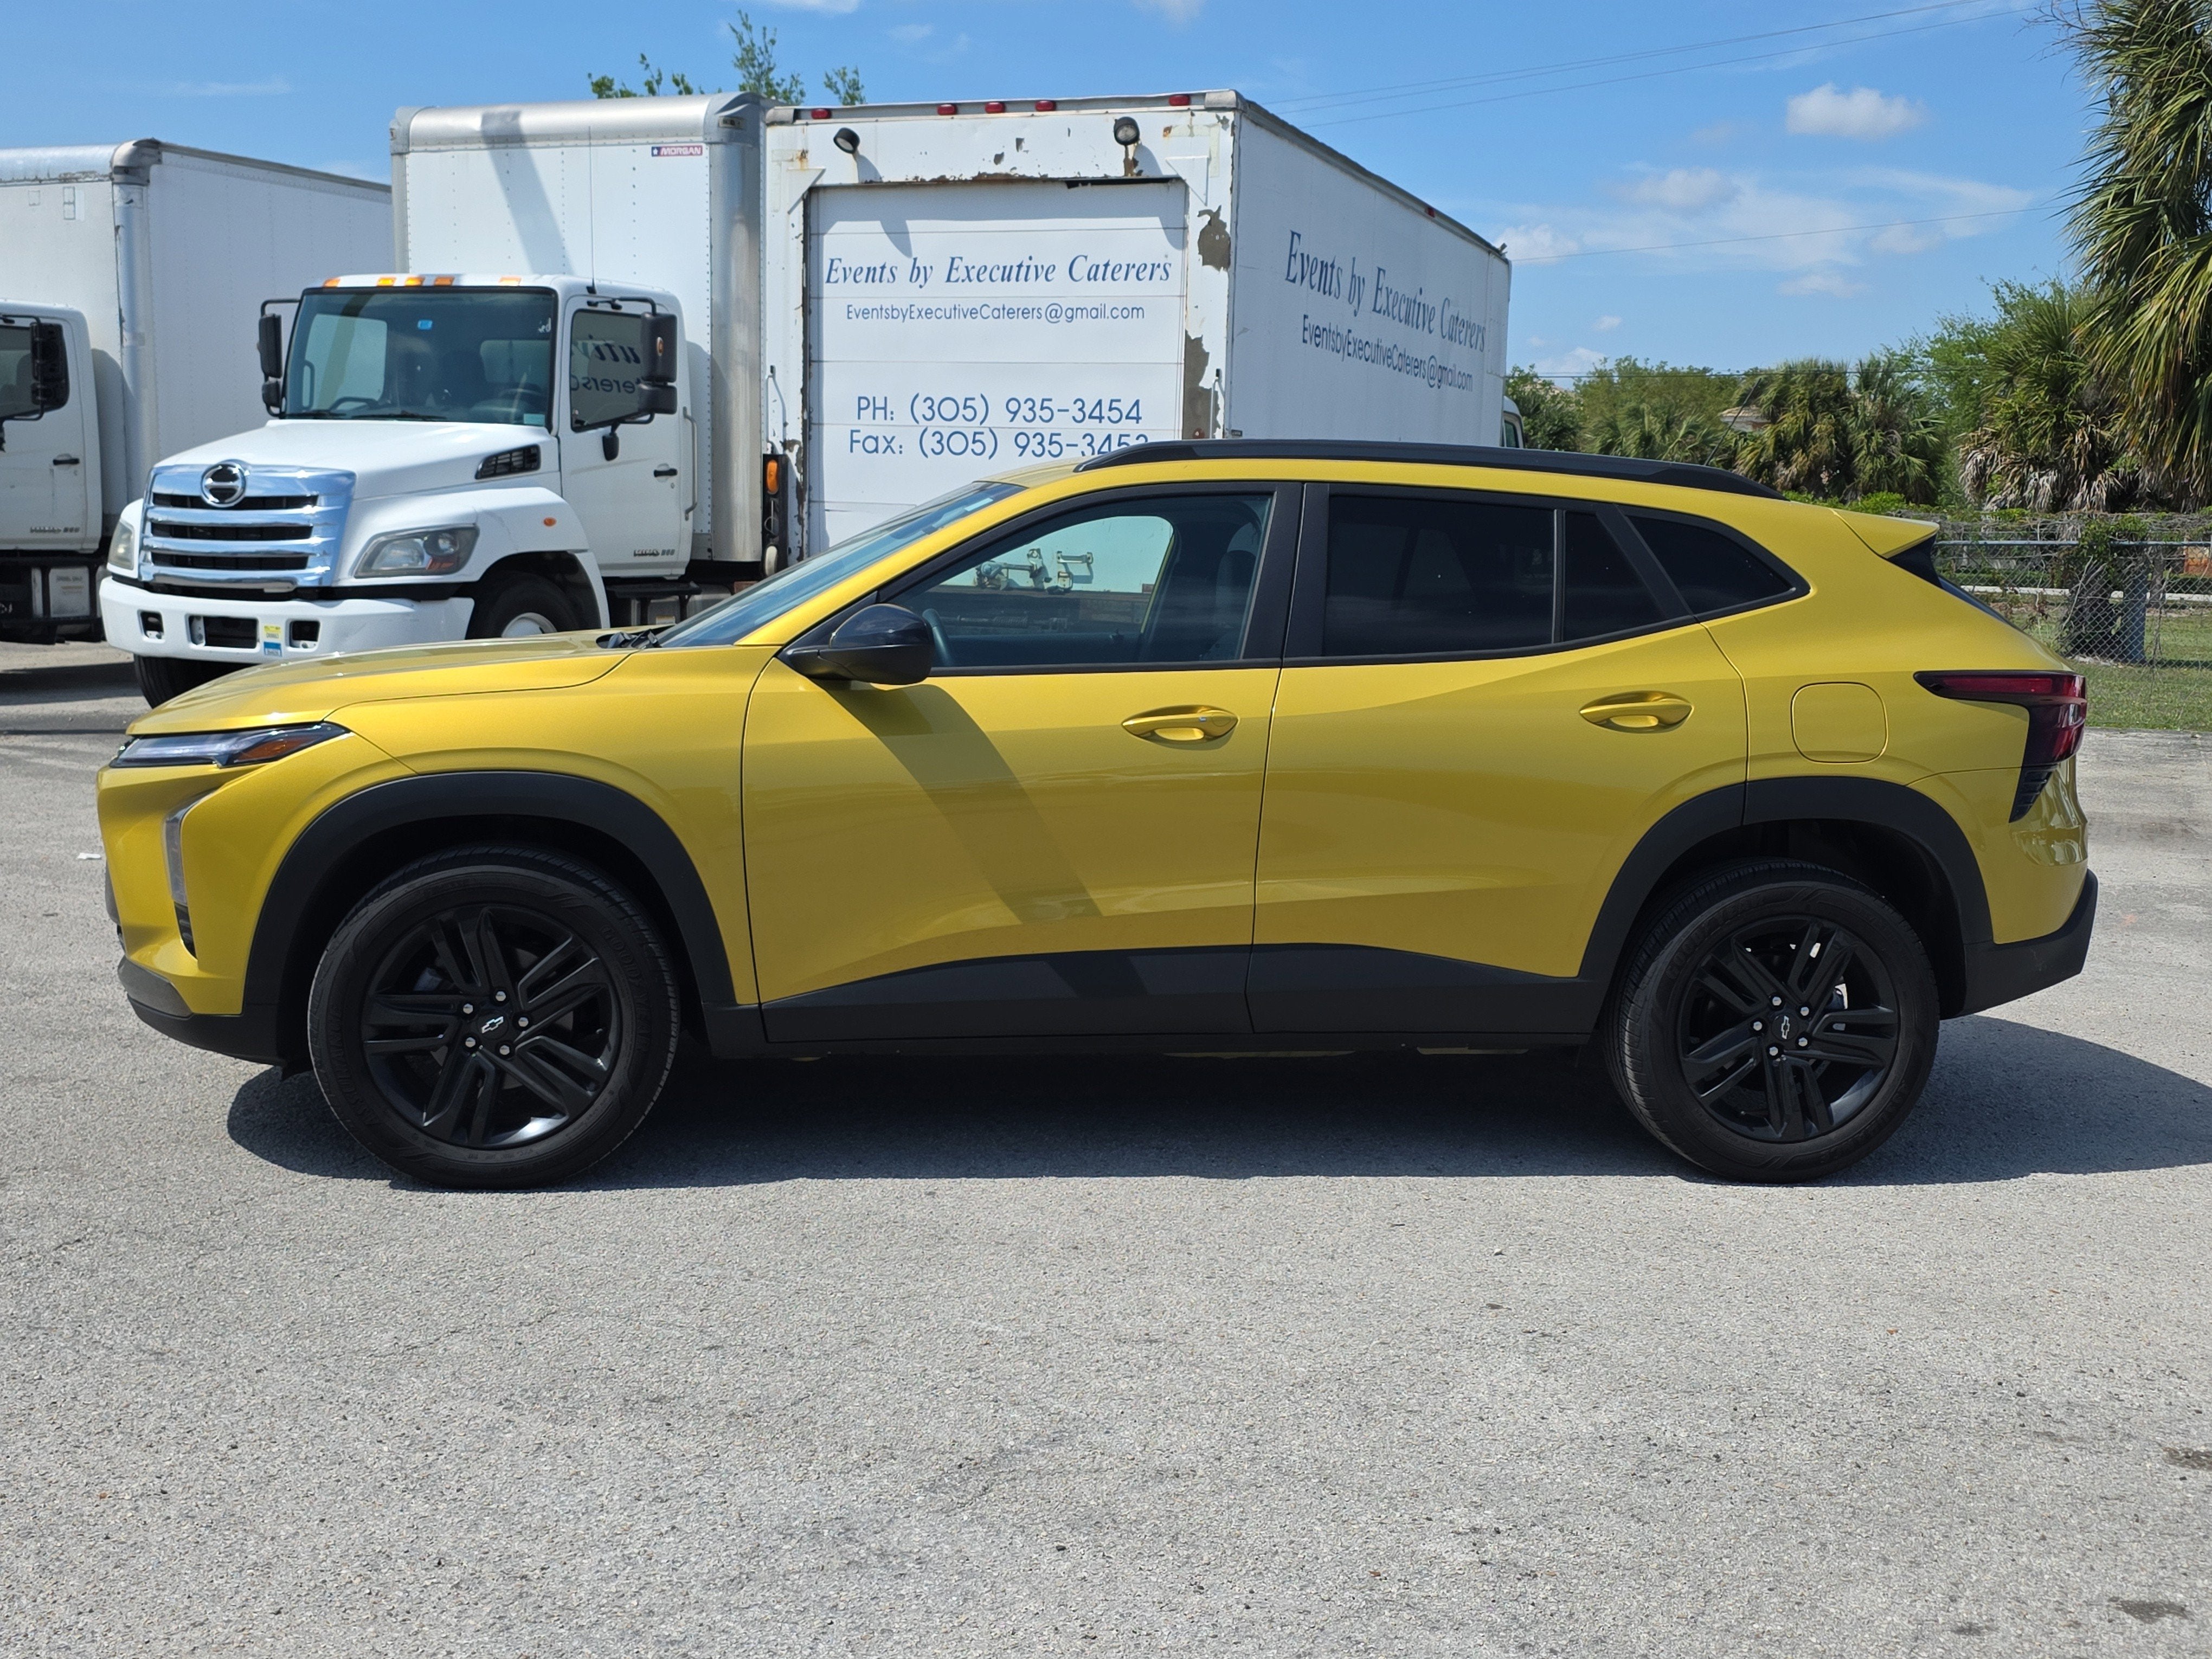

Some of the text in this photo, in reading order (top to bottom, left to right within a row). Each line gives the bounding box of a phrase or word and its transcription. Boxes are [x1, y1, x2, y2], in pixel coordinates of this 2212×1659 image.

[660, 146, 702, 156] MORGAN
[826, 254, 1172, 290] Events by Executive Caterers
[1285, 230, 1486, 352] Events by Executive Caterers
[846, 302, 1145, 324] EventsbyExecutiveCaterers@gmail.com
[1302, 314, 1473, 392] EventsbyExecutiveCaterers@gmail.com
[857, 392, 1142, 426] PH: (305) 935-3454
[850, 429, 903, 455] Fax:
[918, 426, 998, 460] (305)
